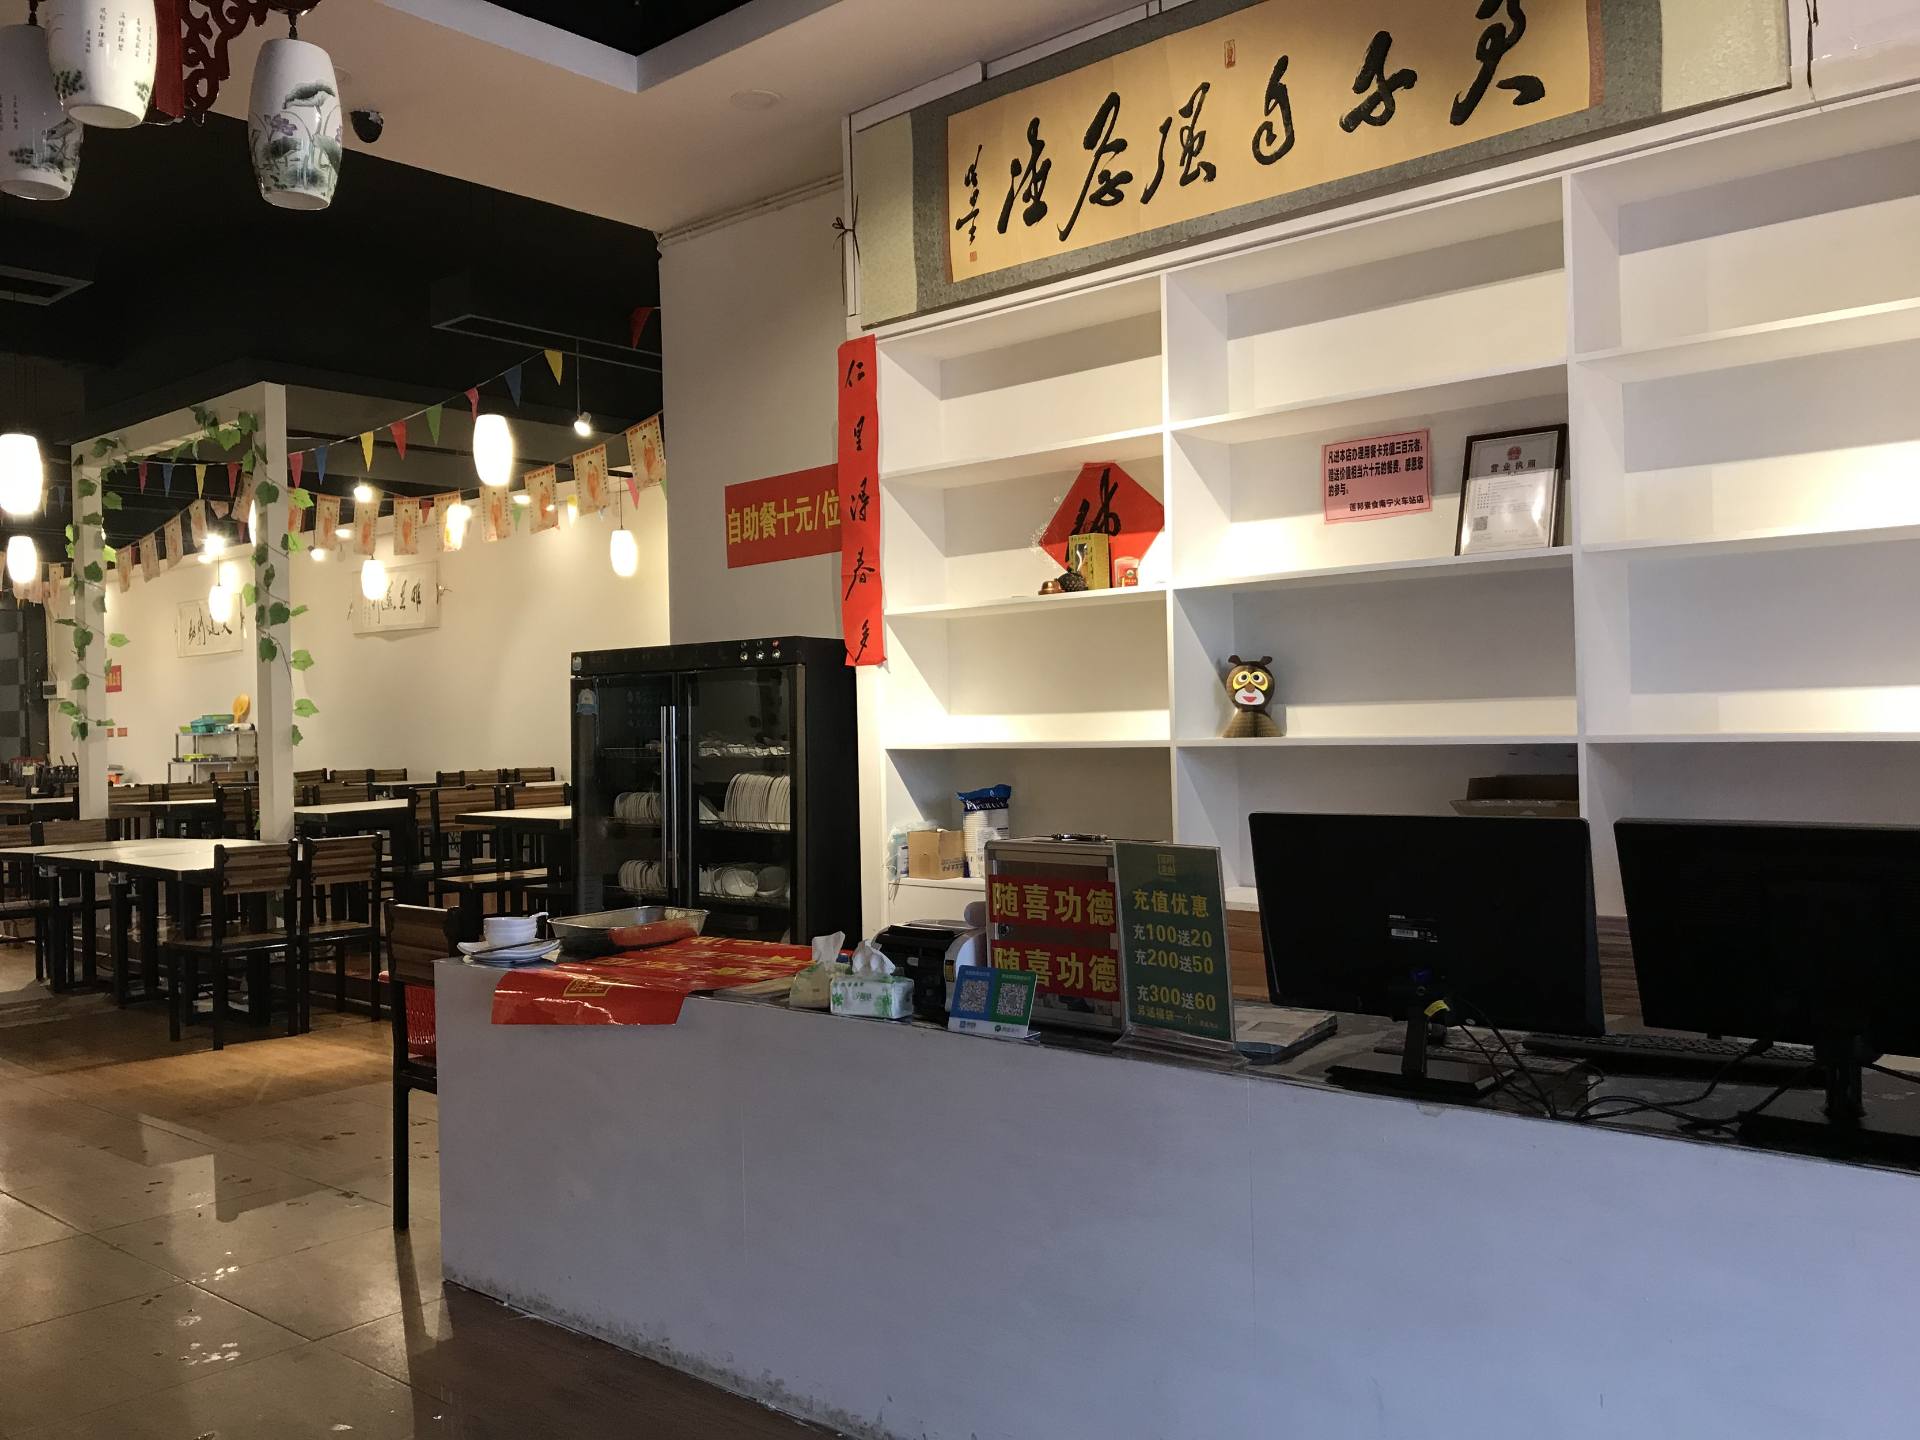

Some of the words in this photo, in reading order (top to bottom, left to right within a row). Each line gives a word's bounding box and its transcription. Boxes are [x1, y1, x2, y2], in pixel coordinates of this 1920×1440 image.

[1490, 459, 1537, 473] 营业执照
[727, 490, 841, 545] 自助餐十元/位
[992, 882, 1115, 926] 随喜功德
[1132, 888, 1209, 918] 充值优惠
[1132, 924, 1213, 948] 充100送20
[993, 947, 1118, 993] 随喜功德
[1134, 949, 1214, 975] 充200送50
[1136, 984, 1216, 1012] 充300送60
